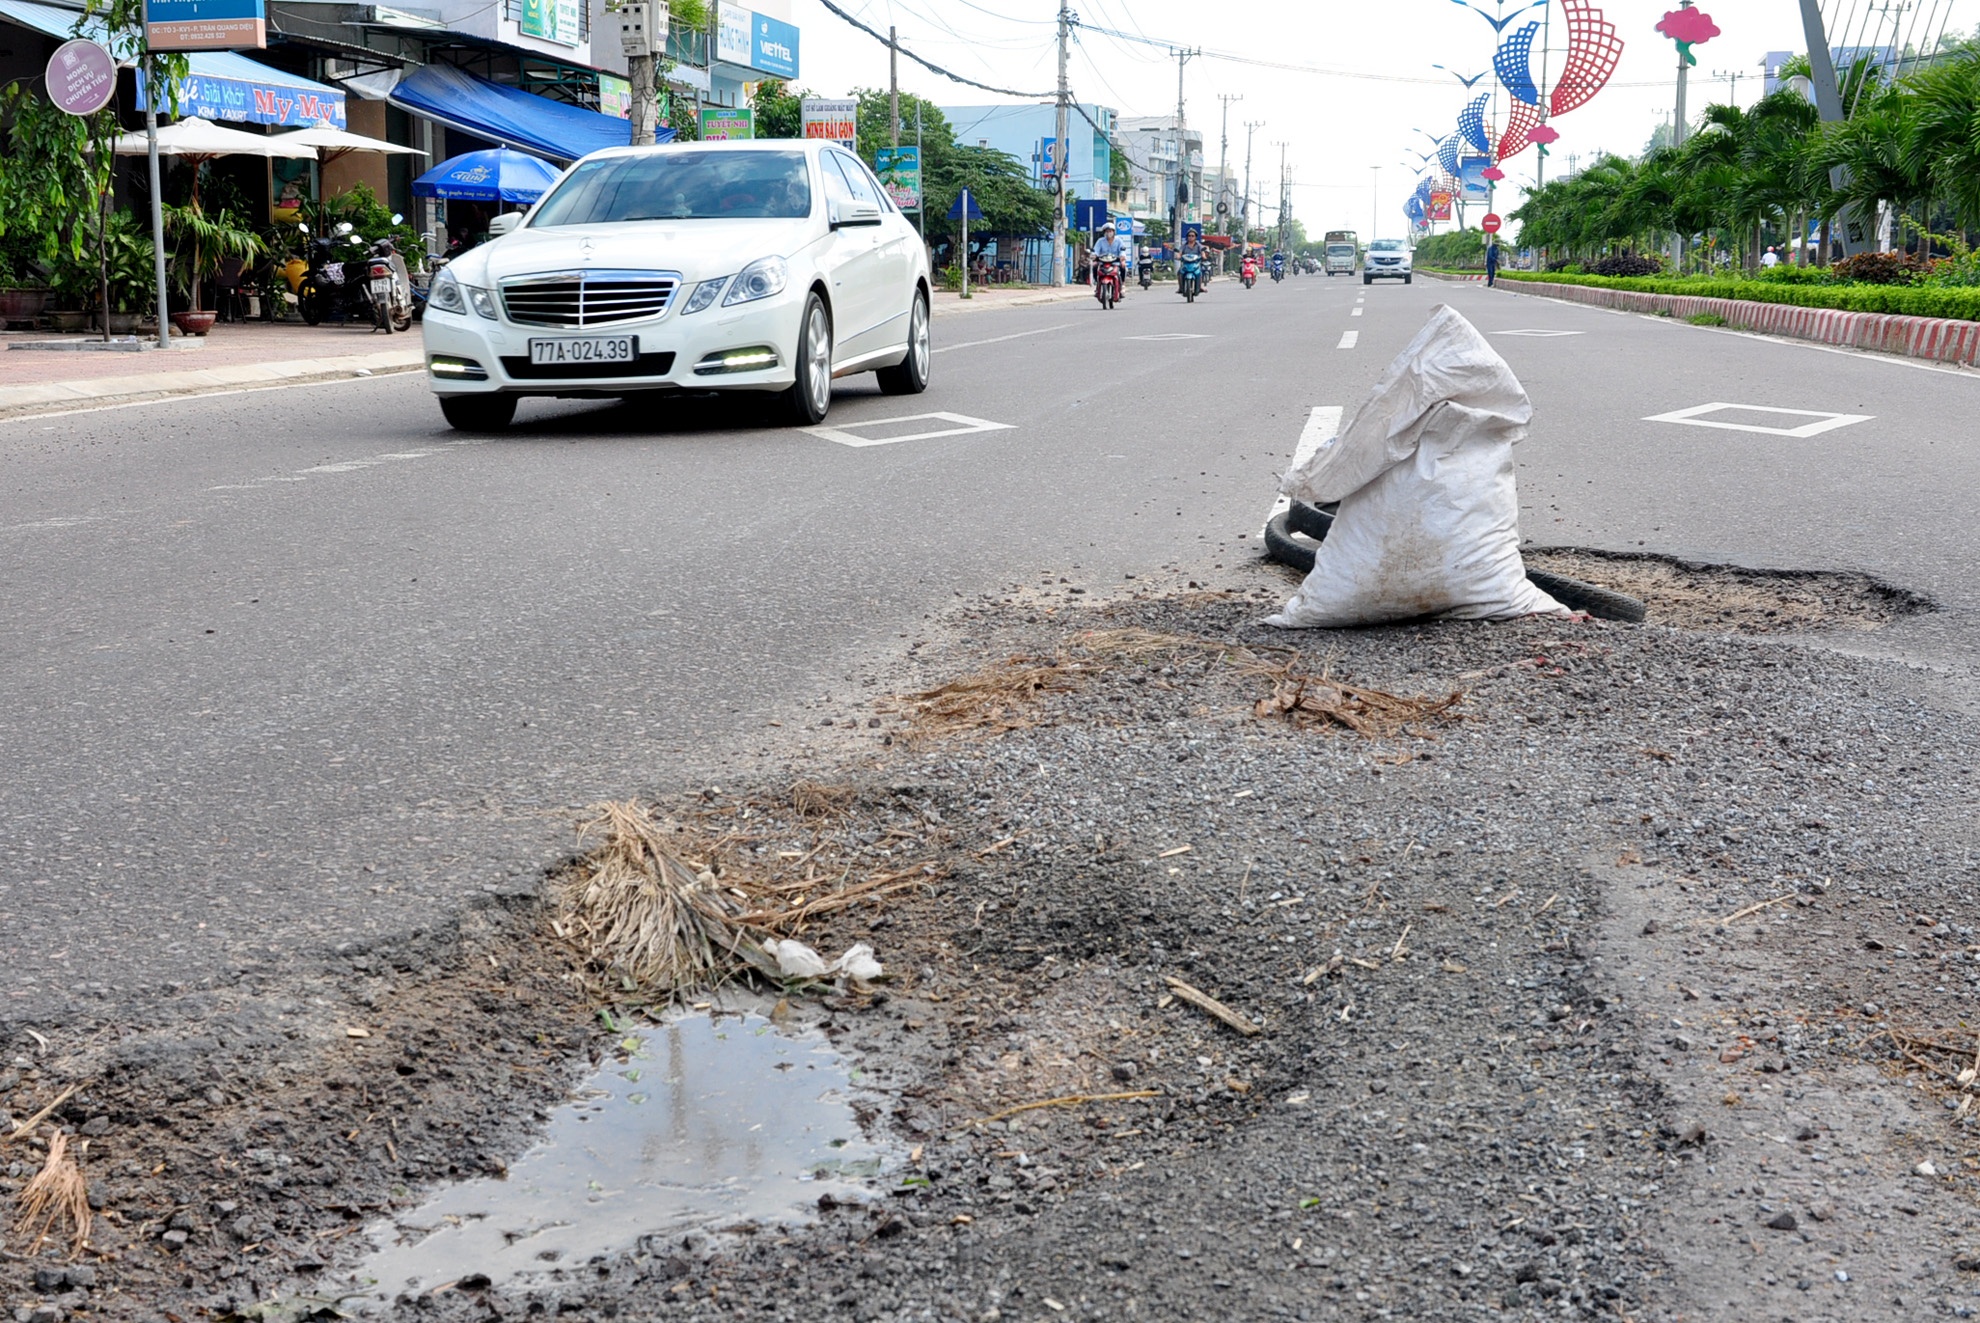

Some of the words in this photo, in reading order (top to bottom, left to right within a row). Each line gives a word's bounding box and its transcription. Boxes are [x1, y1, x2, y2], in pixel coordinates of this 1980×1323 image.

[216, 24, 238, 32] QUANG
[66, 63, 88, 82] MOMO
[84, 70, 95, 81] VỤ
[168, 78, 199, 109] afé
[253, 88, 293, 123] My
[706, 117, 731, 129] TUYẾT
[733, 120, 749, 129] NHI
[805, 120, 824, 139] MINH
[825, 114, 838, 139] SÀI
[839, 114, 854, 139] GÒN
[534, 340, 629, 361] 77A-024.39
